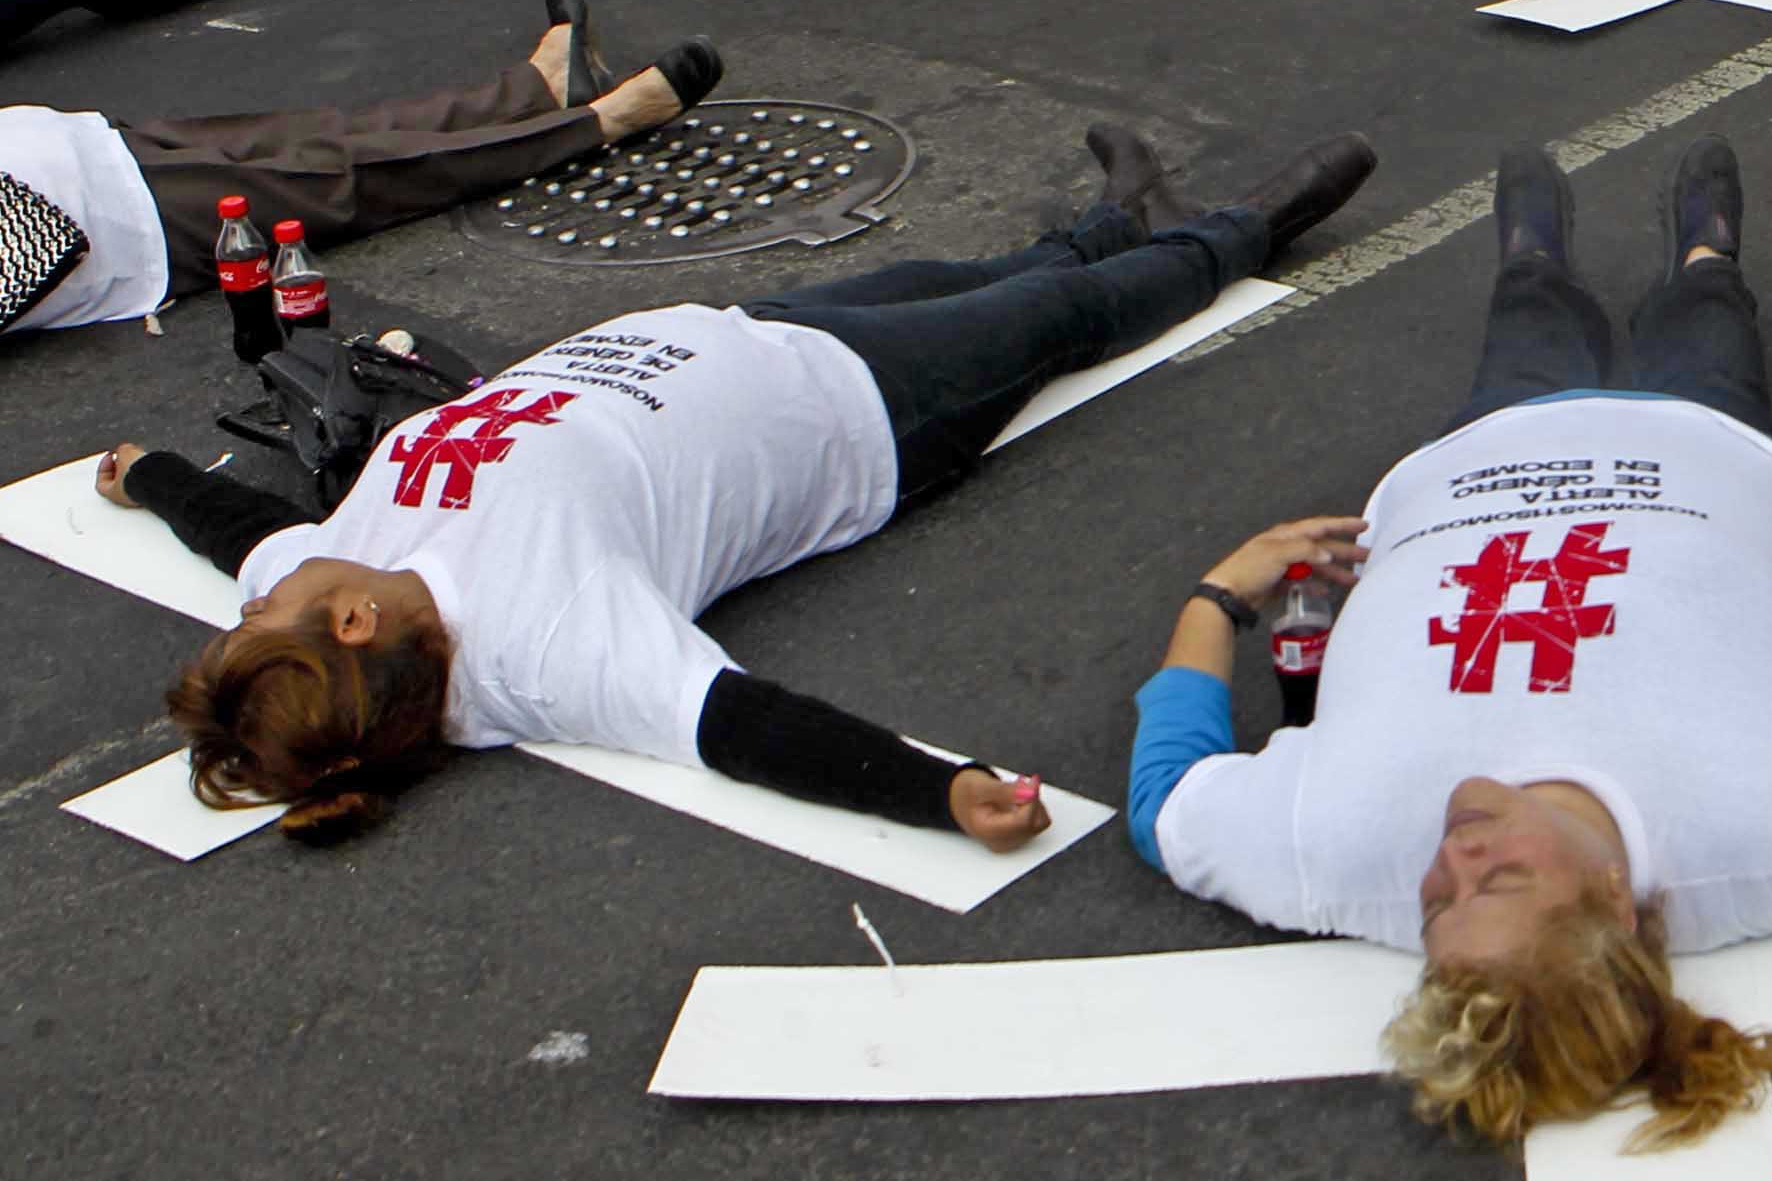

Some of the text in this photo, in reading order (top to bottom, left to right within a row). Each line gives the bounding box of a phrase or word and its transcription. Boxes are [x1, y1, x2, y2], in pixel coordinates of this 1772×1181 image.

[657, 344, 697, 361] EN
[566, 361, 660, 381] ALERTA
[638, 353, 677, 372] DE
[1448, 459, 1661, 488] EN EDOMEX
[1452, 473, 1661, 500] DE GÉNERO
[1520, 487, 1662, 504] ALERTA
